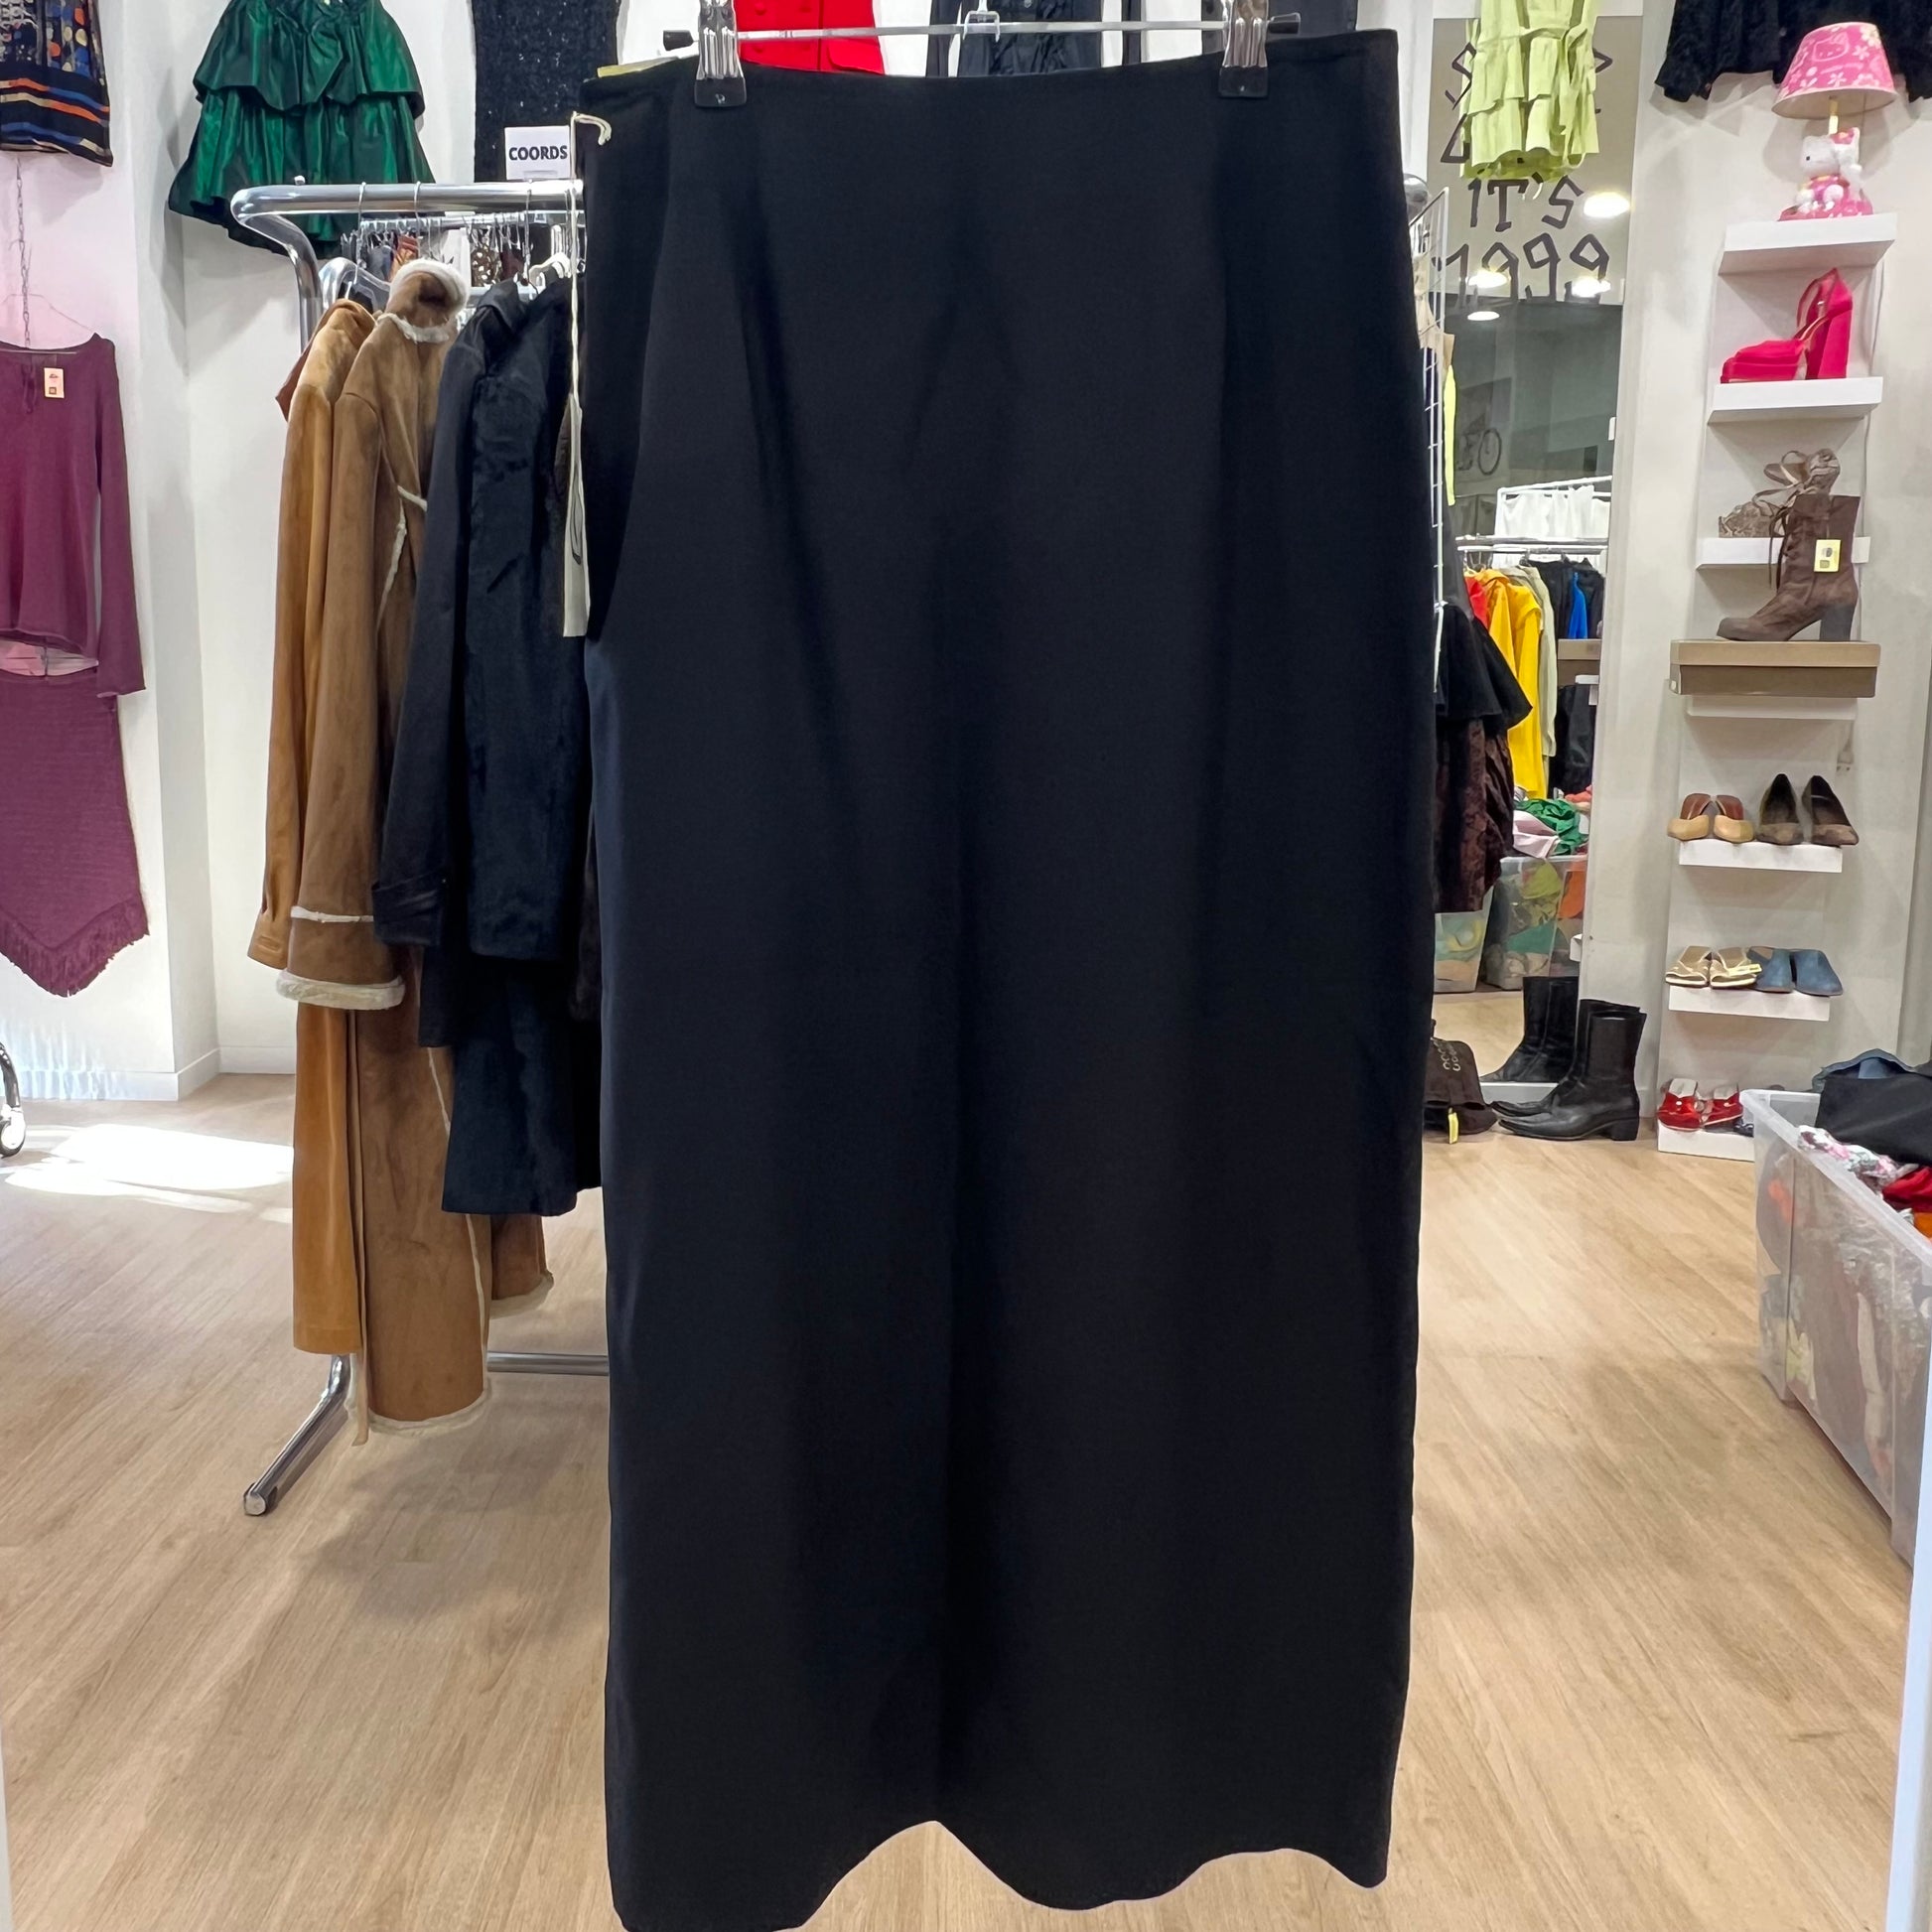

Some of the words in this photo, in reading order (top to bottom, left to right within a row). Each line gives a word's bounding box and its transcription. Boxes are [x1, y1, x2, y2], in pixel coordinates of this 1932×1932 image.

[508, 145, 568, 161] COORDS
[1467, 172, 1585, 232] IT'S
[1432, 232, 1610, 301] 1999
